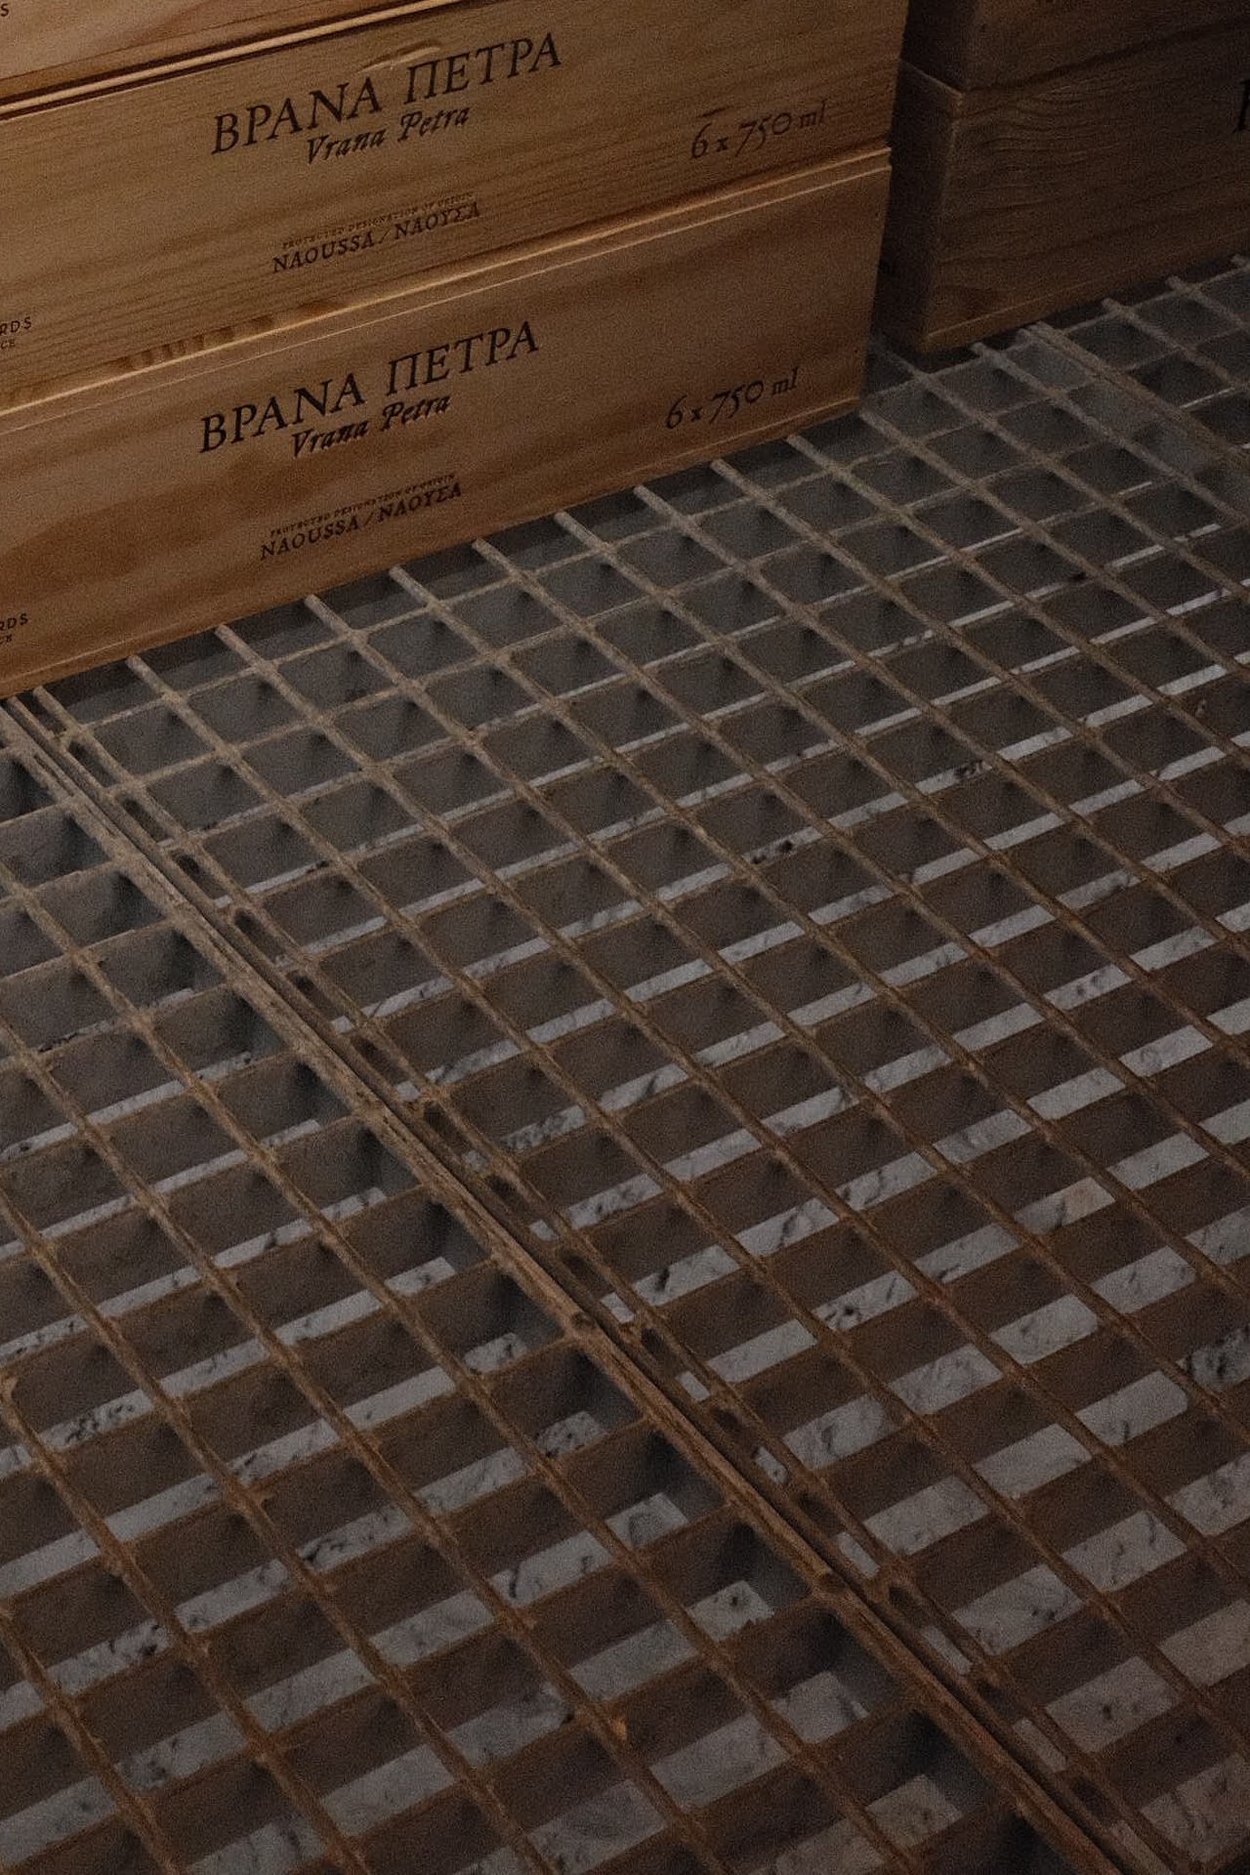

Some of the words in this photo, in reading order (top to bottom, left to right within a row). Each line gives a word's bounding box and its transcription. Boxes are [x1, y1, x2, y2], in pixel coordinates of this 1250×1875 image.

[211, 76, 383, 155] ΒΡΑΝΑ
[403, 32, 563, 106] ΠΕΤΡΑ
[306, 128, 387, 166] Vrana
[397, 105, 471, 143] Petra
[200, 372, 366, 454] ΒΡΑΝΑ
[385, 320, 539, 397] ΠΕΤΡΑ
[291, 420, 369, 459] Vrana
[380, 394, 451, 432] Petra
